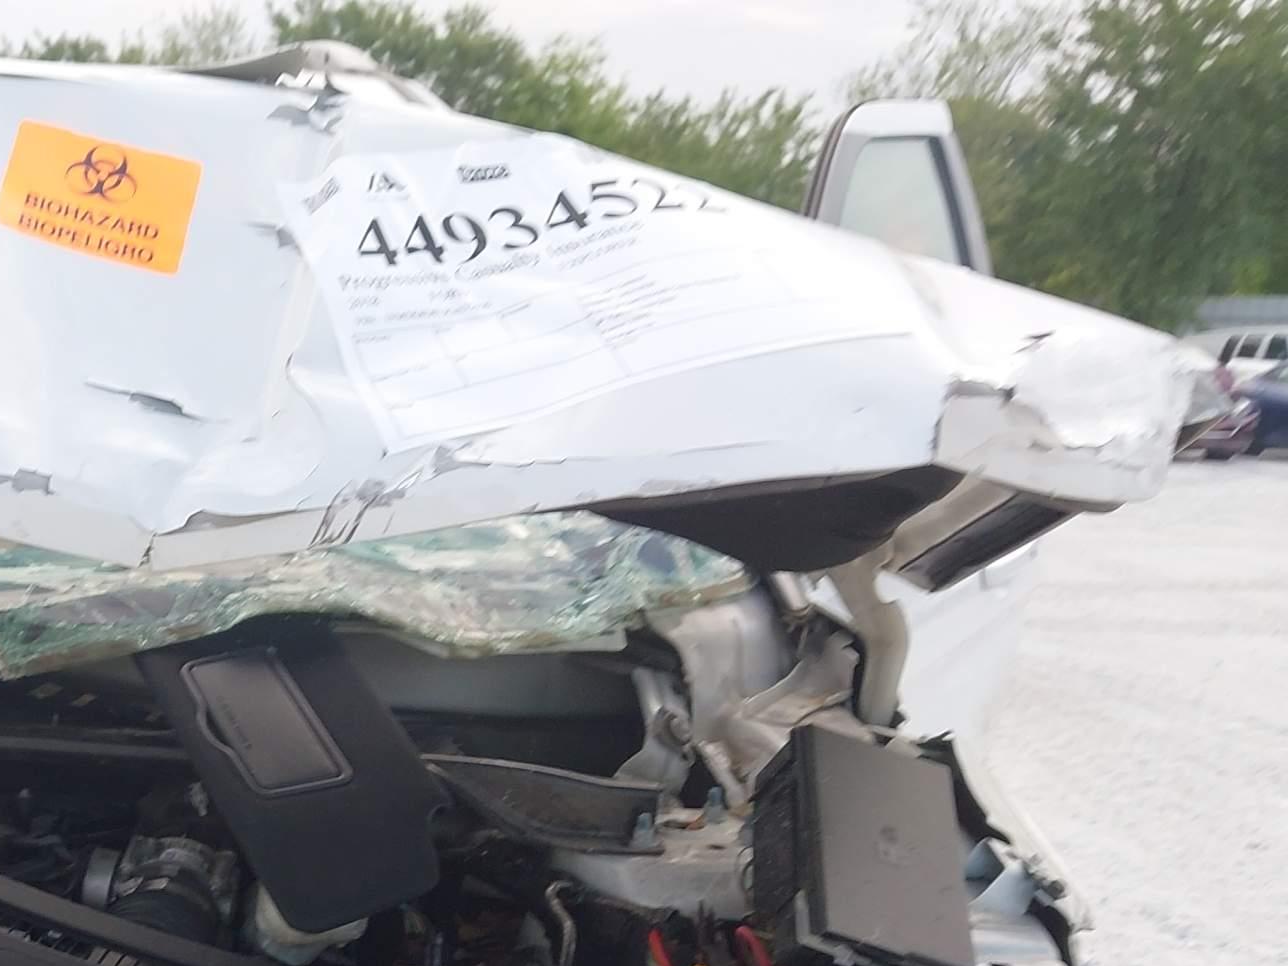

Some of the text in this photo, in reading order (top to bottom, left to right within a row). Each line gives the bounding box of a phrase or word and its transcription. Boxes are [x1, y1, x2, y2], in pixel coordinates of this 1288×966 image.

[18, 214, 154, 263] BIOPELIGRO
[24, 192, 159, 240] BIOHAZARD
[358, 179, 728, 266] 44934522
[455, 250, 540, 283] Casualty
